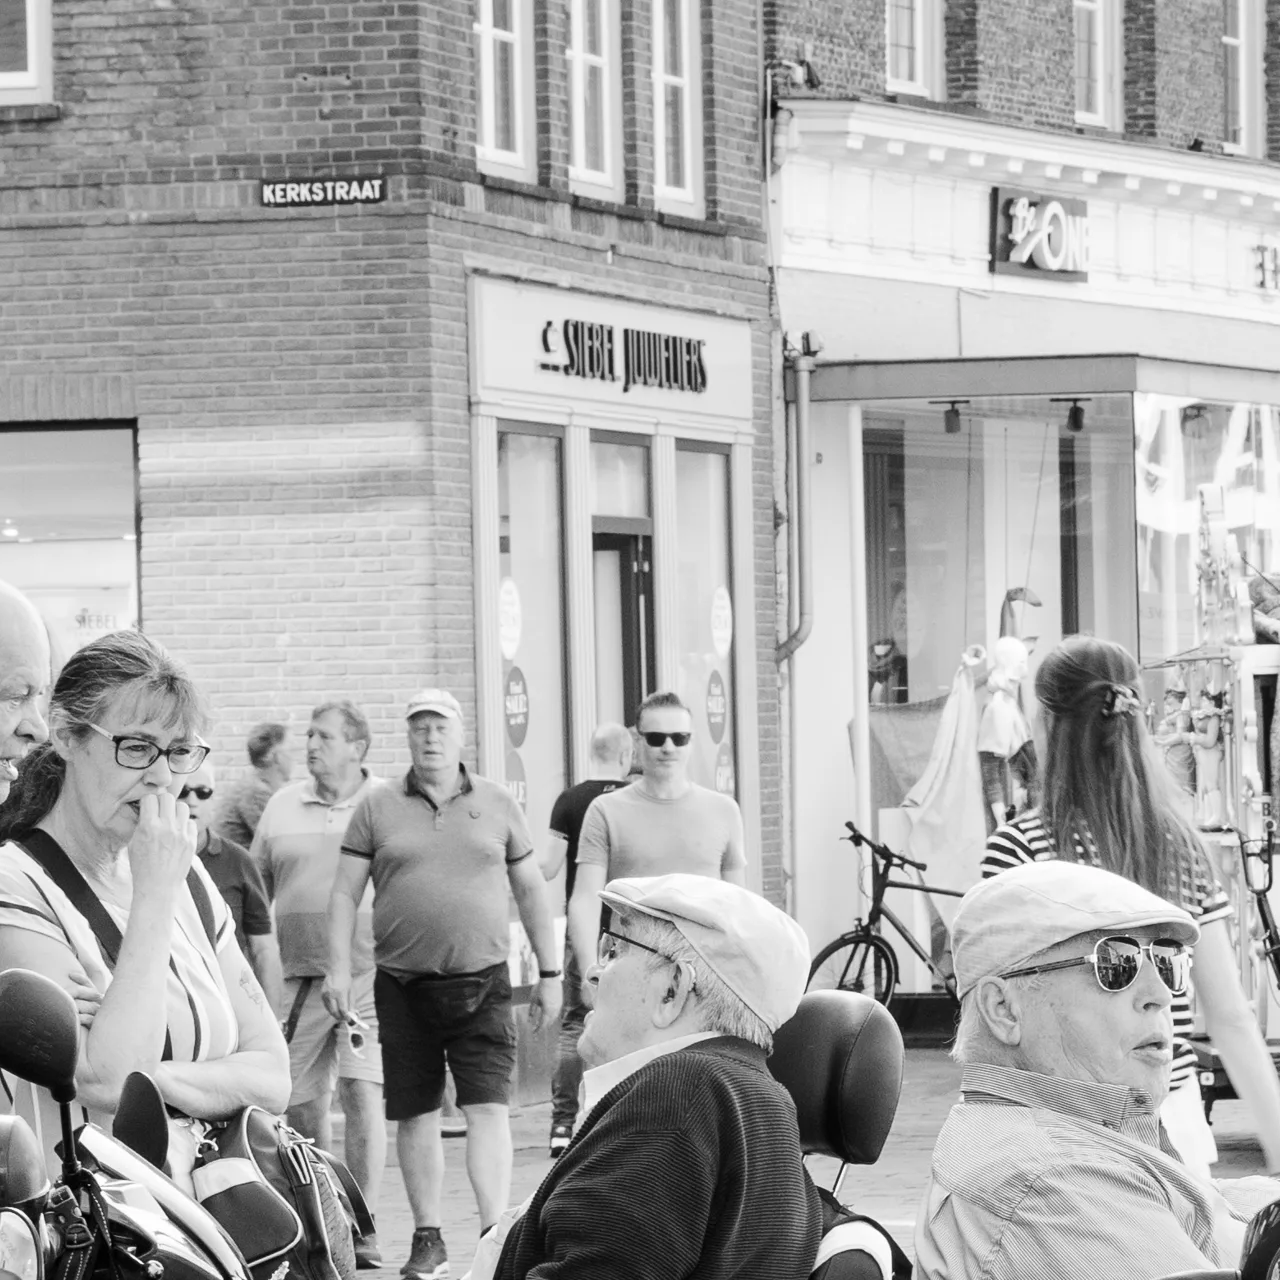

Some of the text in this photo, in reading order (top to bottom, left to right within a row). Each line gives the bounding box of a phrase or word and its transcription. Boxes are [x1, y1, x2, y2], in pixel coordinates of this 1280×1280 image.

[263, 180, 382, 203] KERKSTRAAT
[564, 320, 707, 392] SIEBEL JUWELIERS
